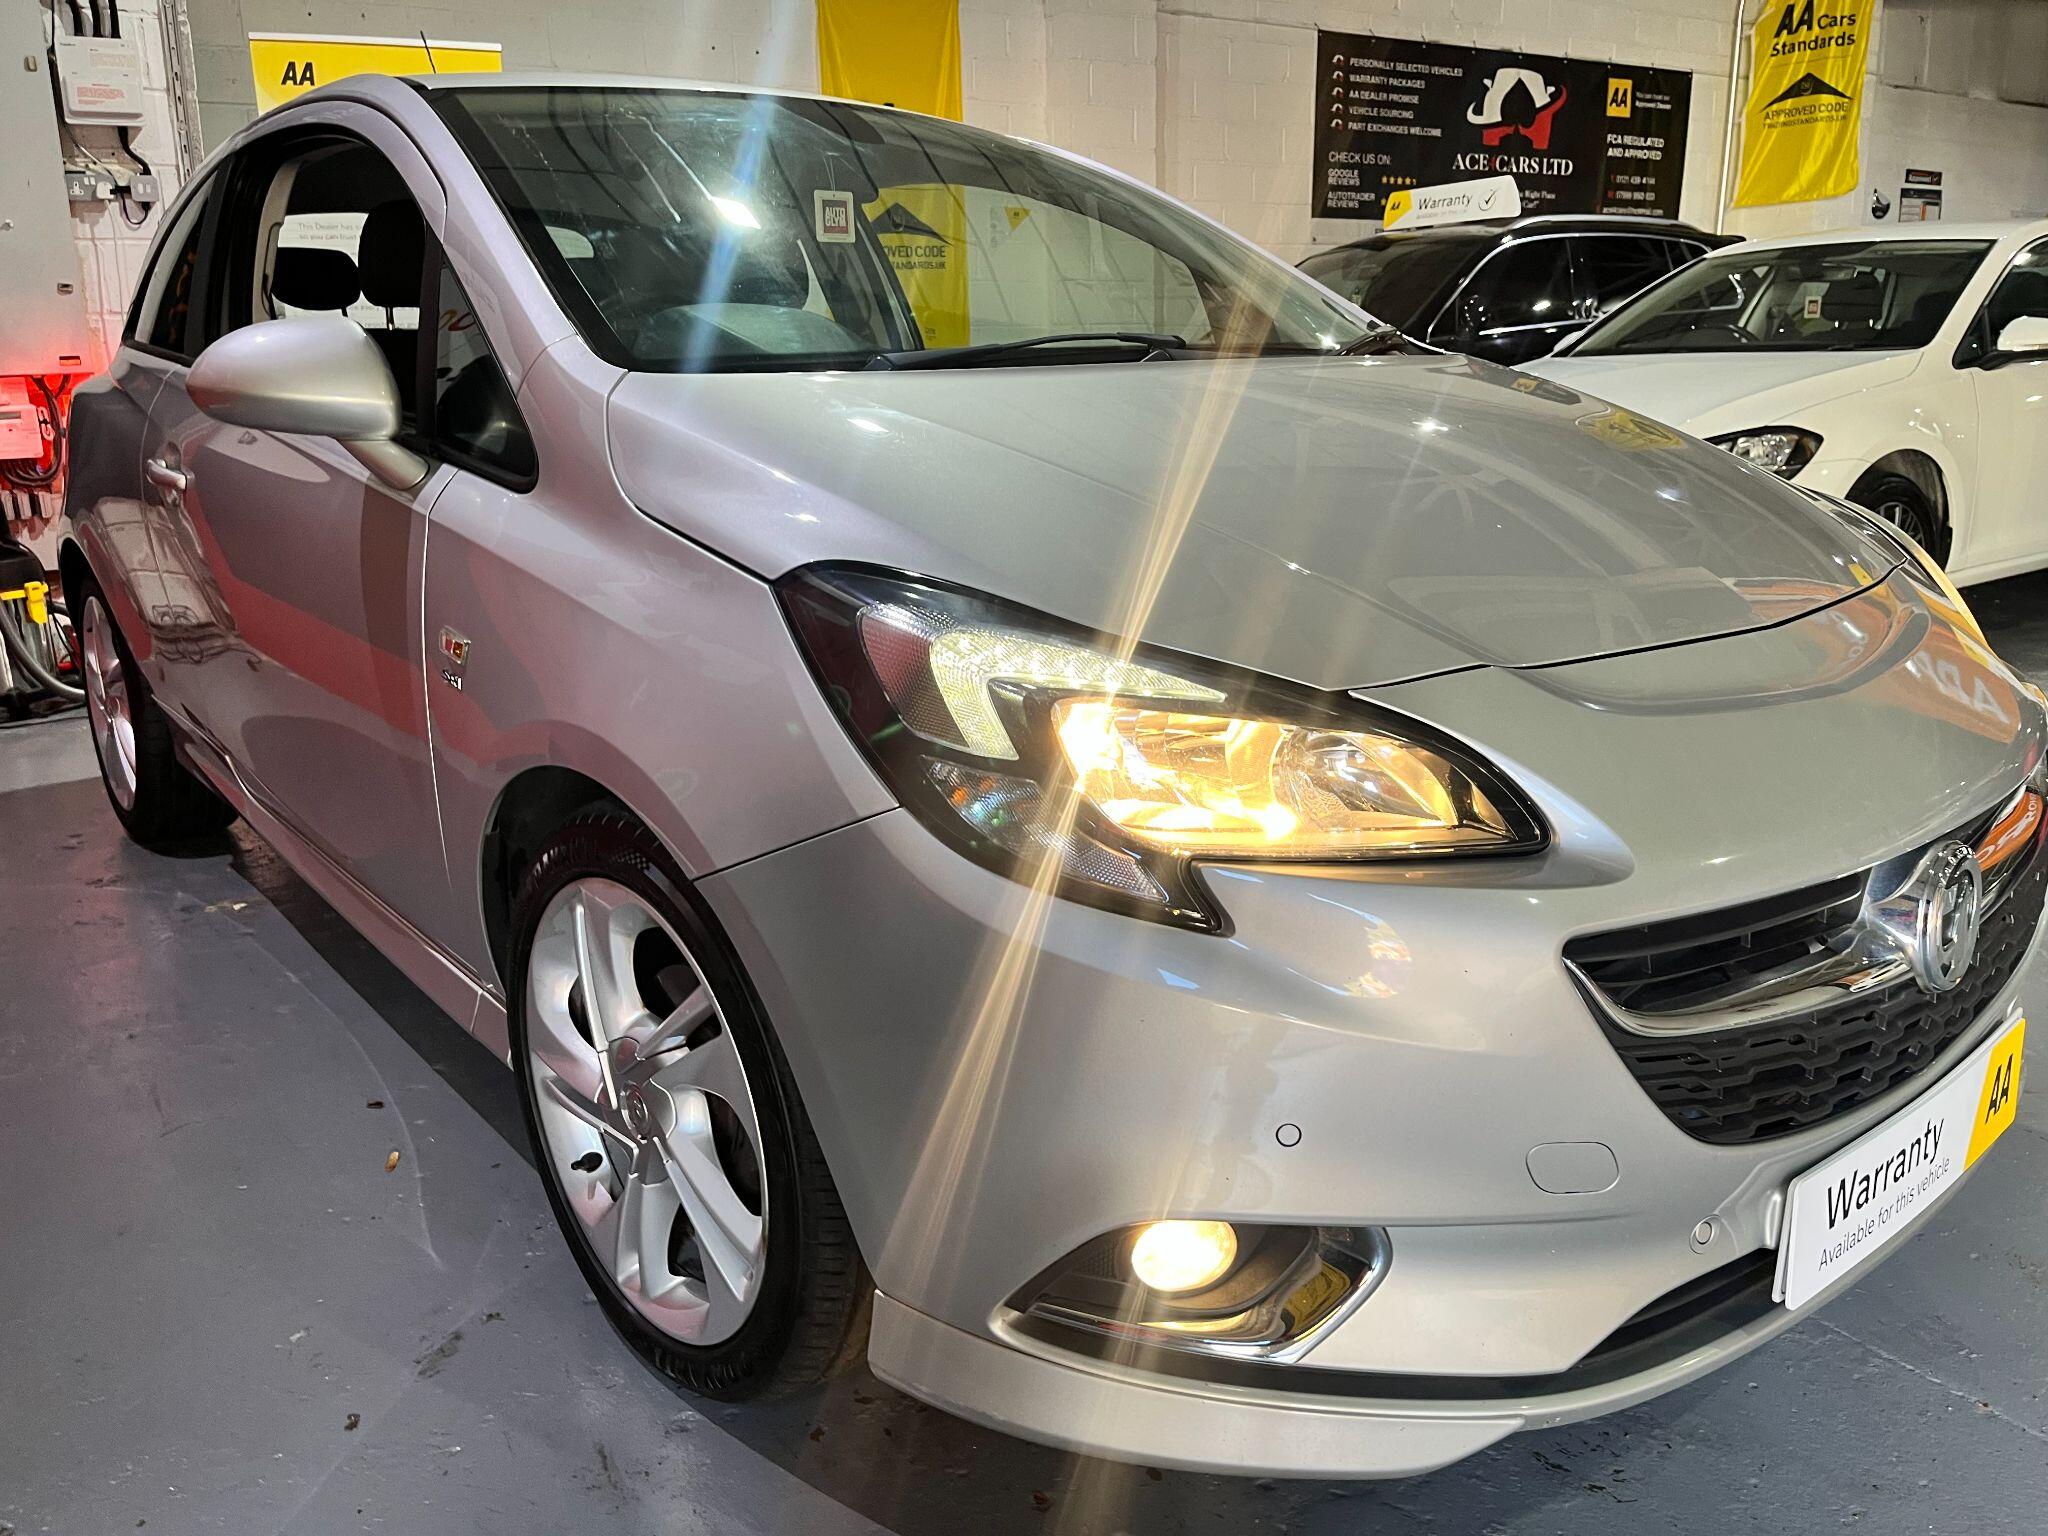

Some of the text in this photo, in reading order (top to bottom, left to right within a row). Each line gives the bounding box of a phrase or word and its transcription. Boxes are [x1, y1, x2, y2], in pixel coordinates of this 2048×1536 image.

[1774, 0, 1857, 38] AA Cars
[1770, 32, 1856, 57] Standards
[281, 61, 316, 86] AA
[1349, 57, 1464, 77] PERSONALLY SELECTED VEHICLES
[1348, 74, 1426, 89] WARRANTY PACKAGES
[1348, 89, 1360, 99] AA
[1360, 91, 1388, 101] DEALER
[1609, 87, 1629, 108] AA
[1348, 106, 1415, 119] VEHICLE SOURCING
[1763, 102, 1849, 122] APPROVED CODE
[1347, 121, 1443, 137] PART EXCHANGES WELCOME
[1606, 133, 1665, 148] FCA REGULATED
[1328, 151, 1361, 164] CHECK
[1363, 153, 1376, 165] US
[1606, 147, 1663, 160] AND APPROVED
[1327, 168, 1359, 178] GOOGLE
[1542, 157, 1573, 176] LTD
[1327, 177, 1361, 187] REVIEWS
[1327, 191, 1376, 202] AUTOTRADER
[1418, 193, 1473, 211] Warranty
[825, 206, 846, 218] AUTO
[1326, 200, 1360, 209] REVIEWS
[298, 222, 314, 231] This
[825, 216, 847, 227] GLYM
[914, 245, 946, 258] CODE
[1985, 1053, 2014, 1125] AA
[1827, 1118, 1945, 1230] Warranty
[1819, 1156, 1951, 1272] Available for this vehicle
